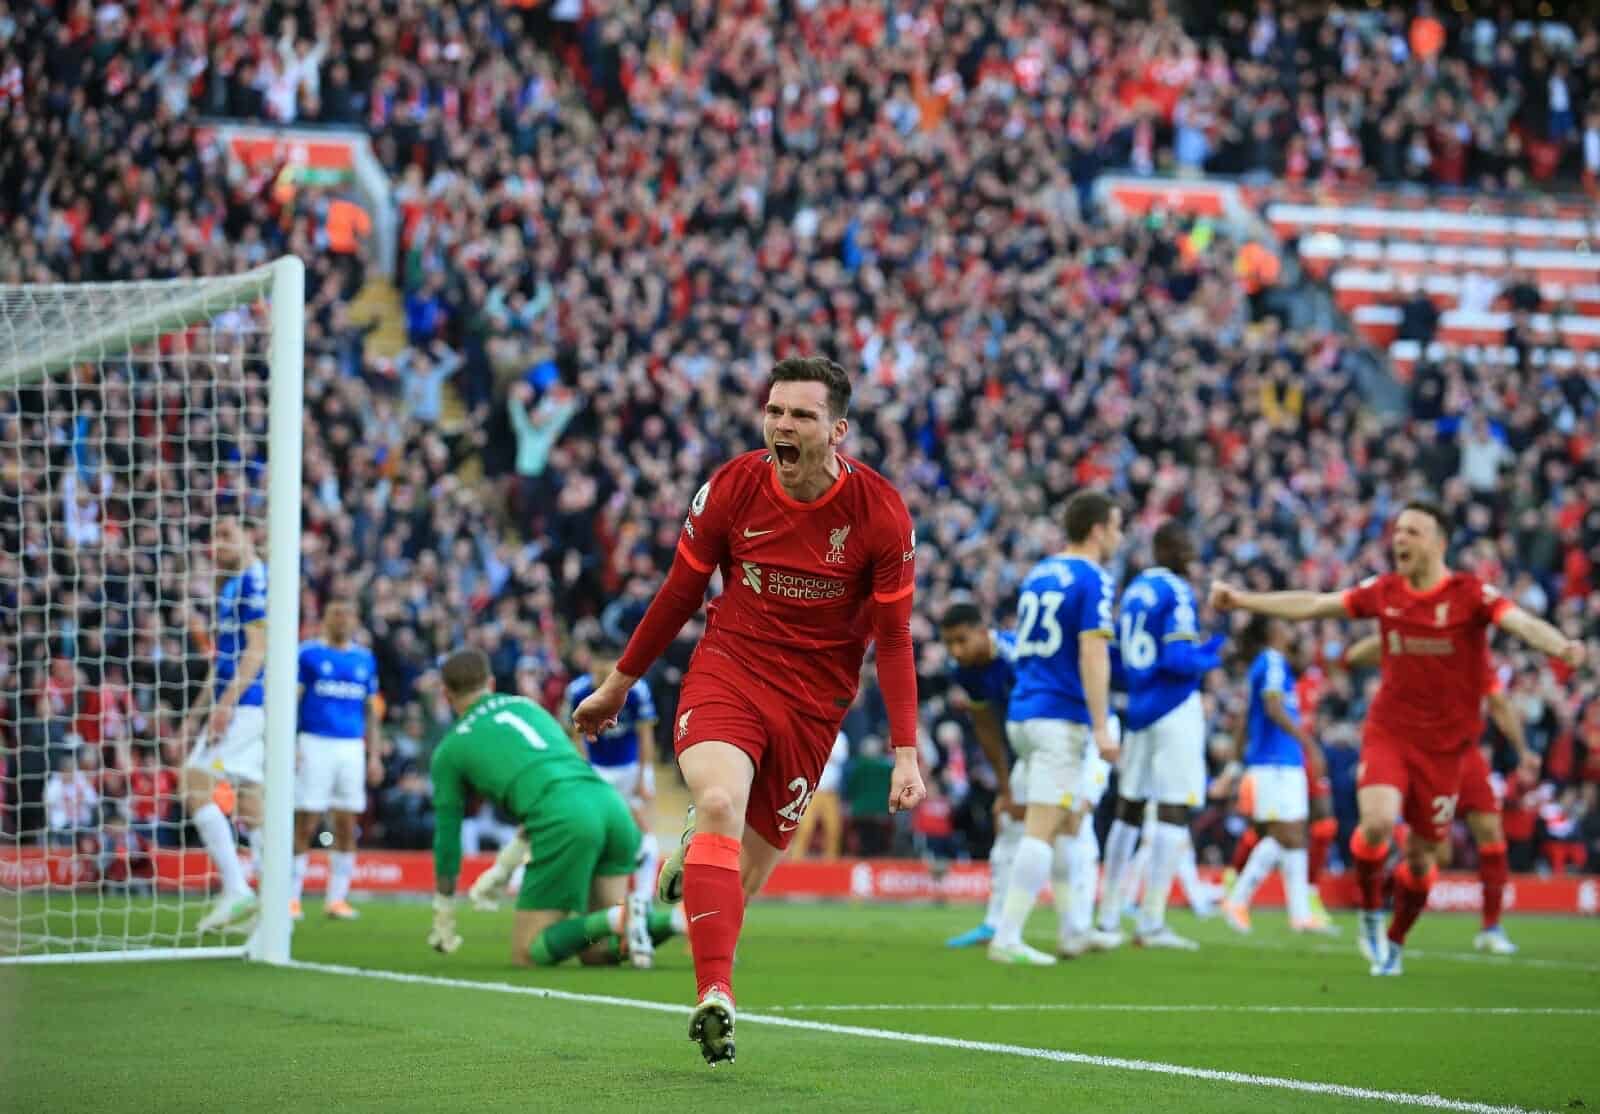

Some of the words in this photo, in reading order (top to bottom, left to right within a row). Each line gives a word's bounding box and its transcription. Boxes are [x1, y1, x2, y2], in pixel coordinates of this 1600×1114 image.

[826, 551, 846, 564] LFC
[768, 572, 846, 590] standard
[768, 584, 846, 599] chartered
[1016, 591, 1065, 659] 23
[1120, 610, 1157, 670] 16
[493, 710, 549, 750] 1
